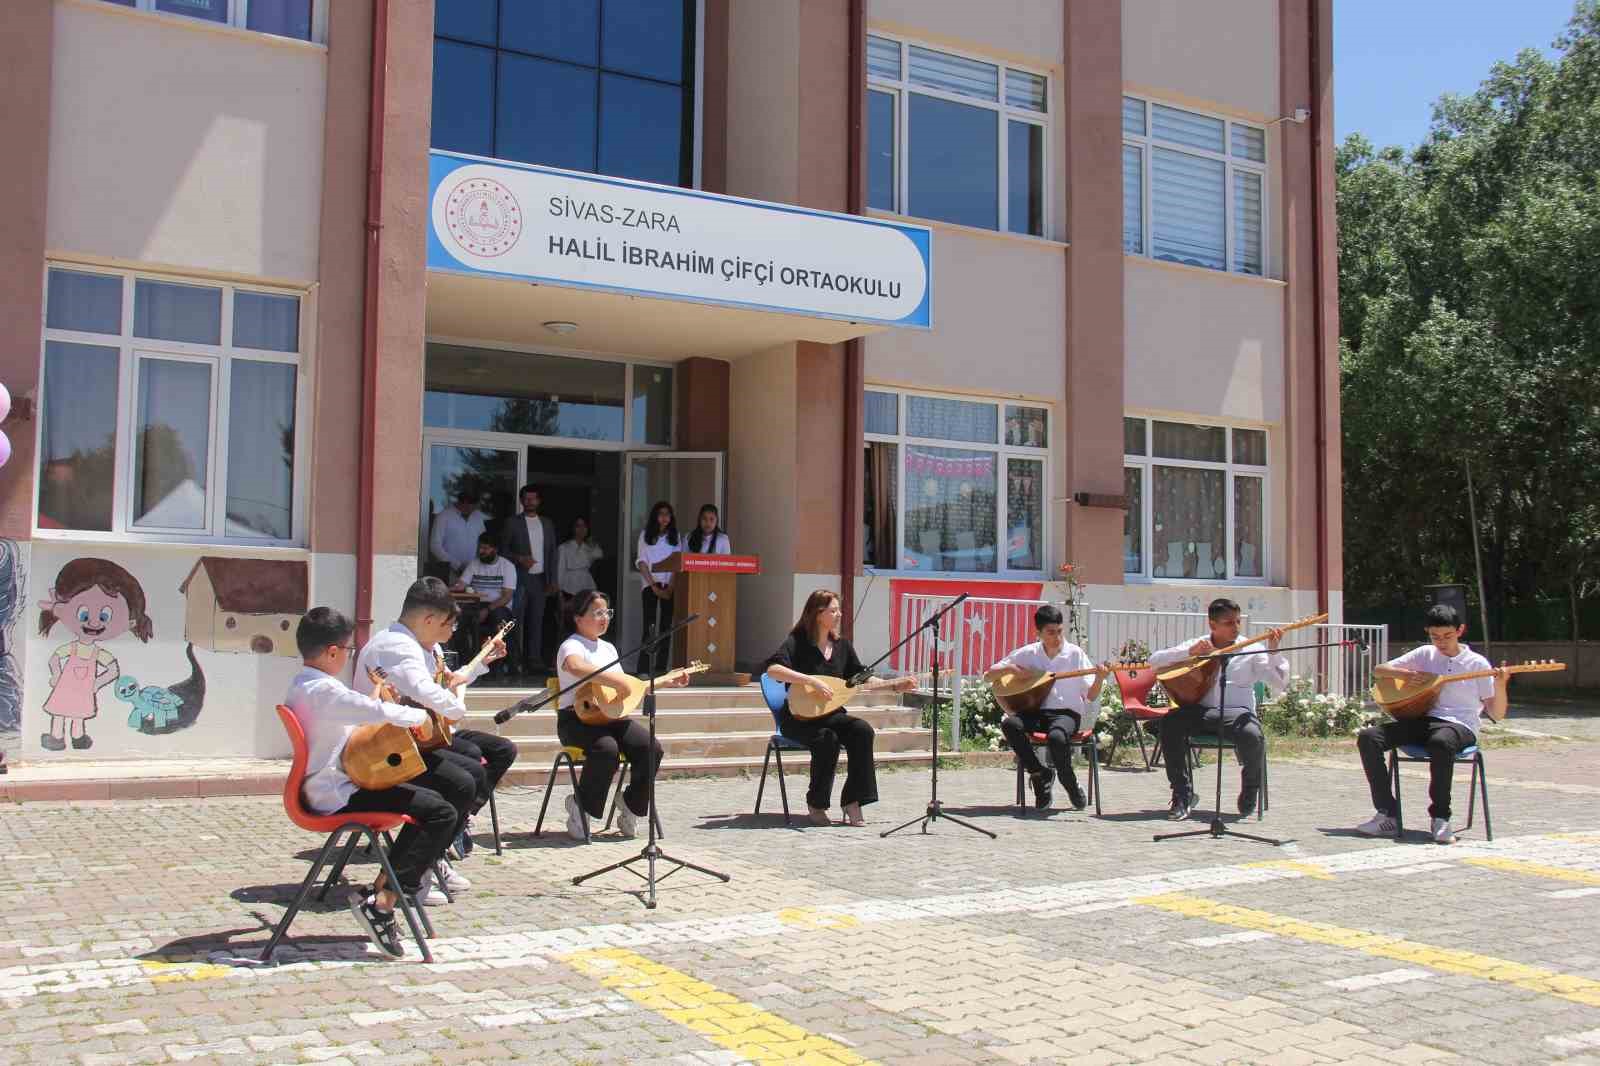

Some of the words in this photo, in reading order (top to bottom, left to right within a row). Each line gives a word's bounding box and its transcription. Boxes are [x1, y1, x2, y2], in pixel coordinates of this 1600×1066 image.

[549, 196, 681, 233] SİVAS-ZARA
[548, 235, 615, 262] HALİL
[622, 240, 714, 275] İBRAHİM
[721, 256, 774, 286] ÇİFÇİ
[780, 267, 901, 298] ORTAOKULU
